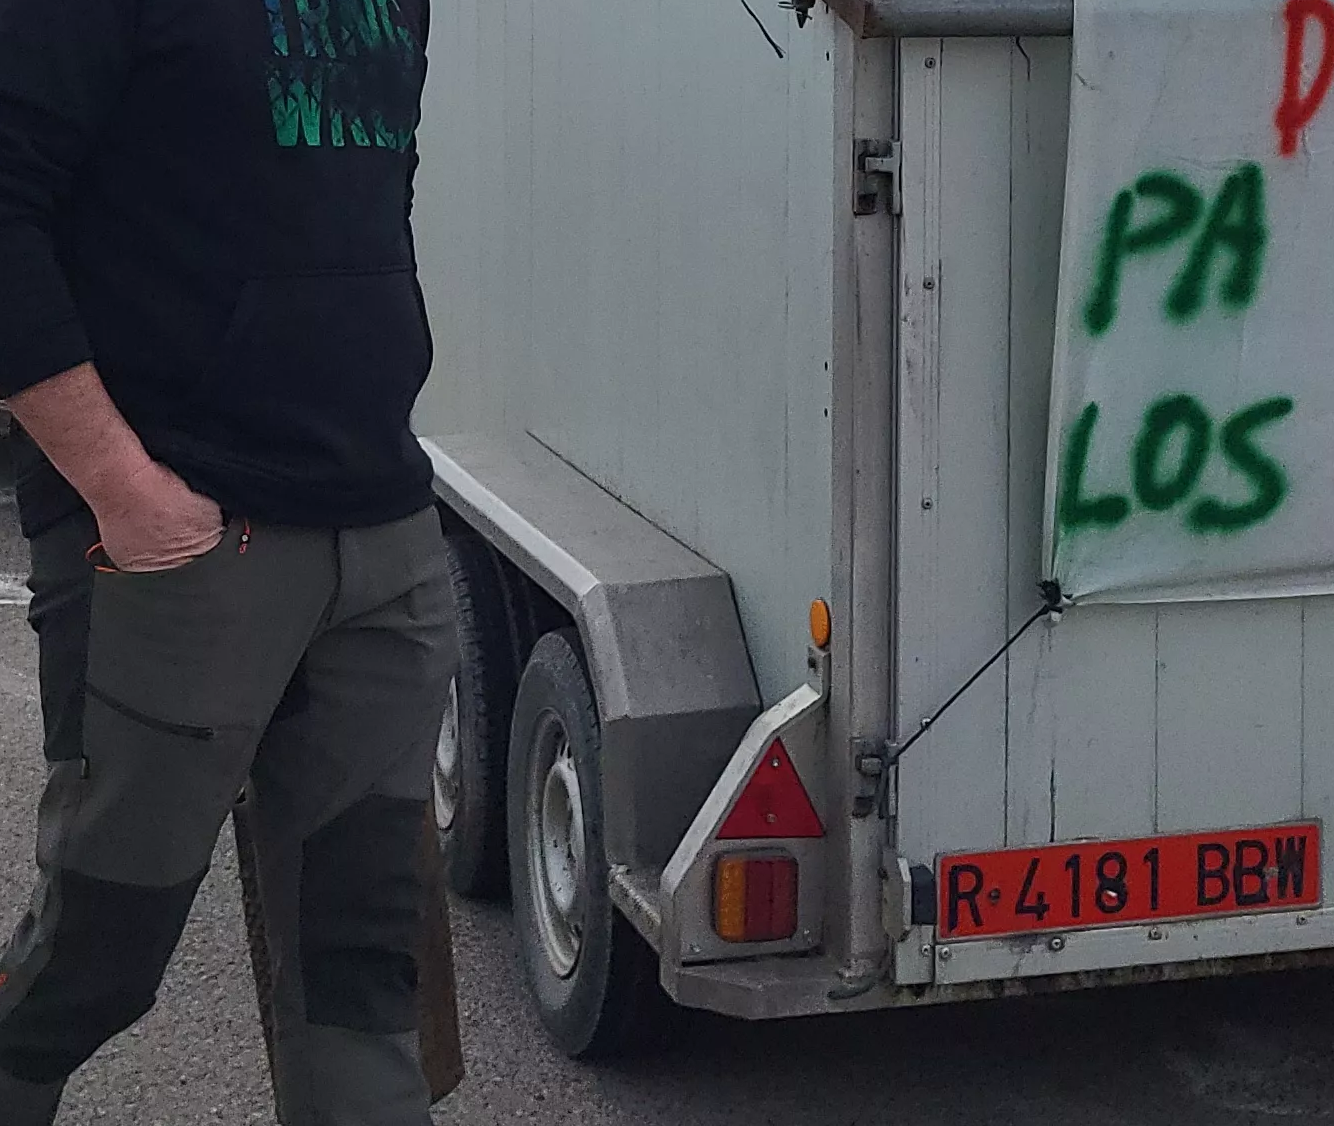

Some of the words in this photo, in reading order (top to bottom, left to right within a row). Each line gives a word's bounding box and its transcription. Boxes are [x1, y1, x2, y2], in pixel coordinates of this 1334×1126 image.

[1083, 162, 1267, 334] PA
[1060, 393, 1293, 531] LOS
[1014, 847, 1160, 921] 4181
[1197, 836, 1307, 906] BBW
